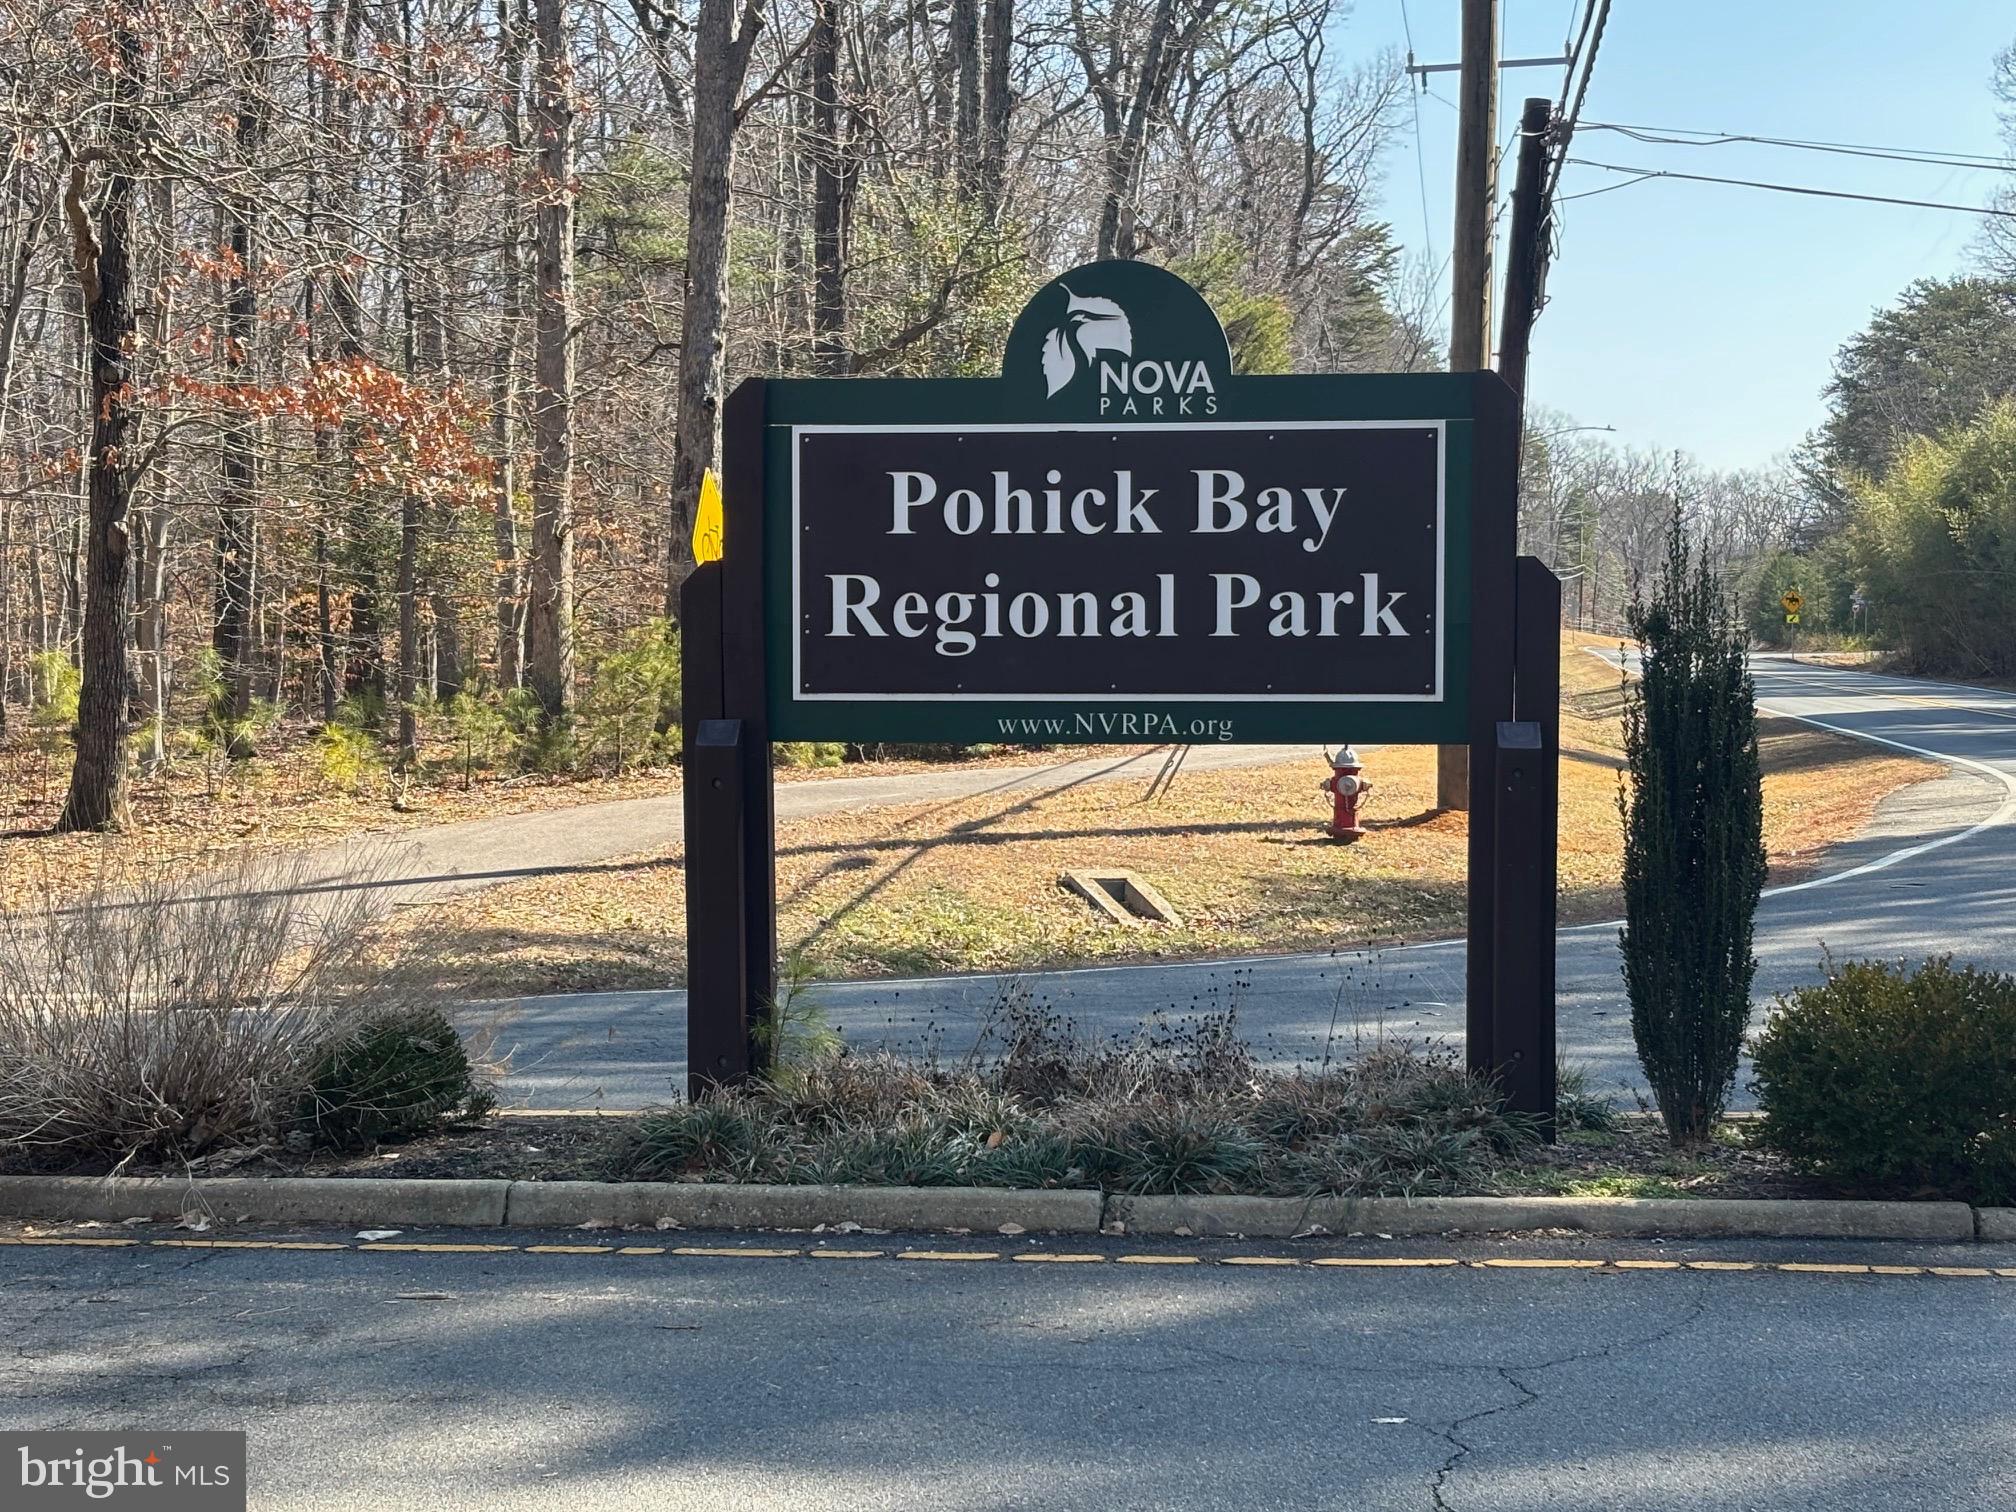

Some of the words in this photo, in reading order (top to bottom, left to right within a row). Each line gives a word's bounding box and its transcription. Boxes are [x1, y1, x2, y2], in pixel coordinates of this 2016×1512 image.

[1100, 360, 1215, 395] NOVA
[1100, 396, 1218, 416] PARKS
[886, 469, 1163, 535] Pohick
[1190, 469, 1348, 553] Bay
[824, 572, 1179, 657] Regional
[1209, 572, 1411, 638] Park
[998, 712, 1234, 742] www.NVRPA.org
